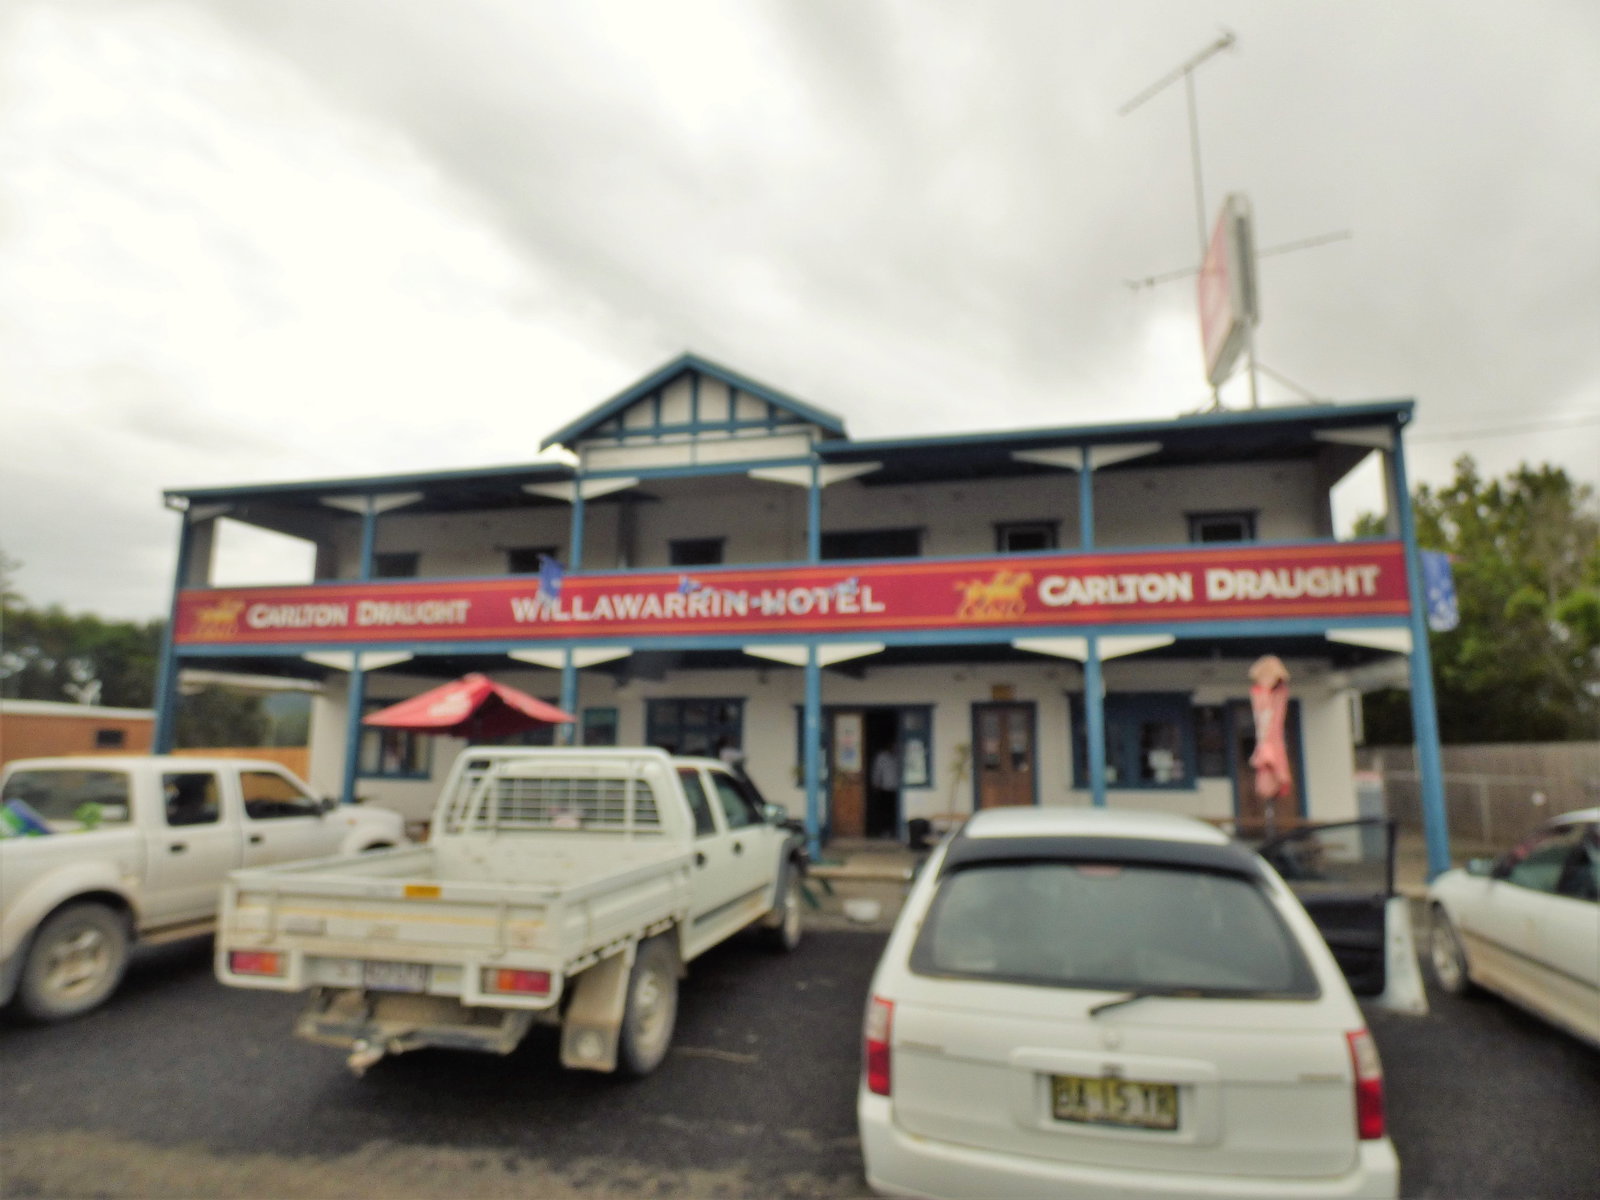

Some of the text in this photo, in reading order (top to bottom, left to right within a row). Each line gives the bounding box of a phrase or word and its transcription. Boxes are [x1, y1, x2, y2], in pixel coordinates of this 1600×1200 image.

[1038, 565, 1380, 606] CARLTON DRAUGHT
[246, 600, 471, 629] CARLTON DRAUGHT
